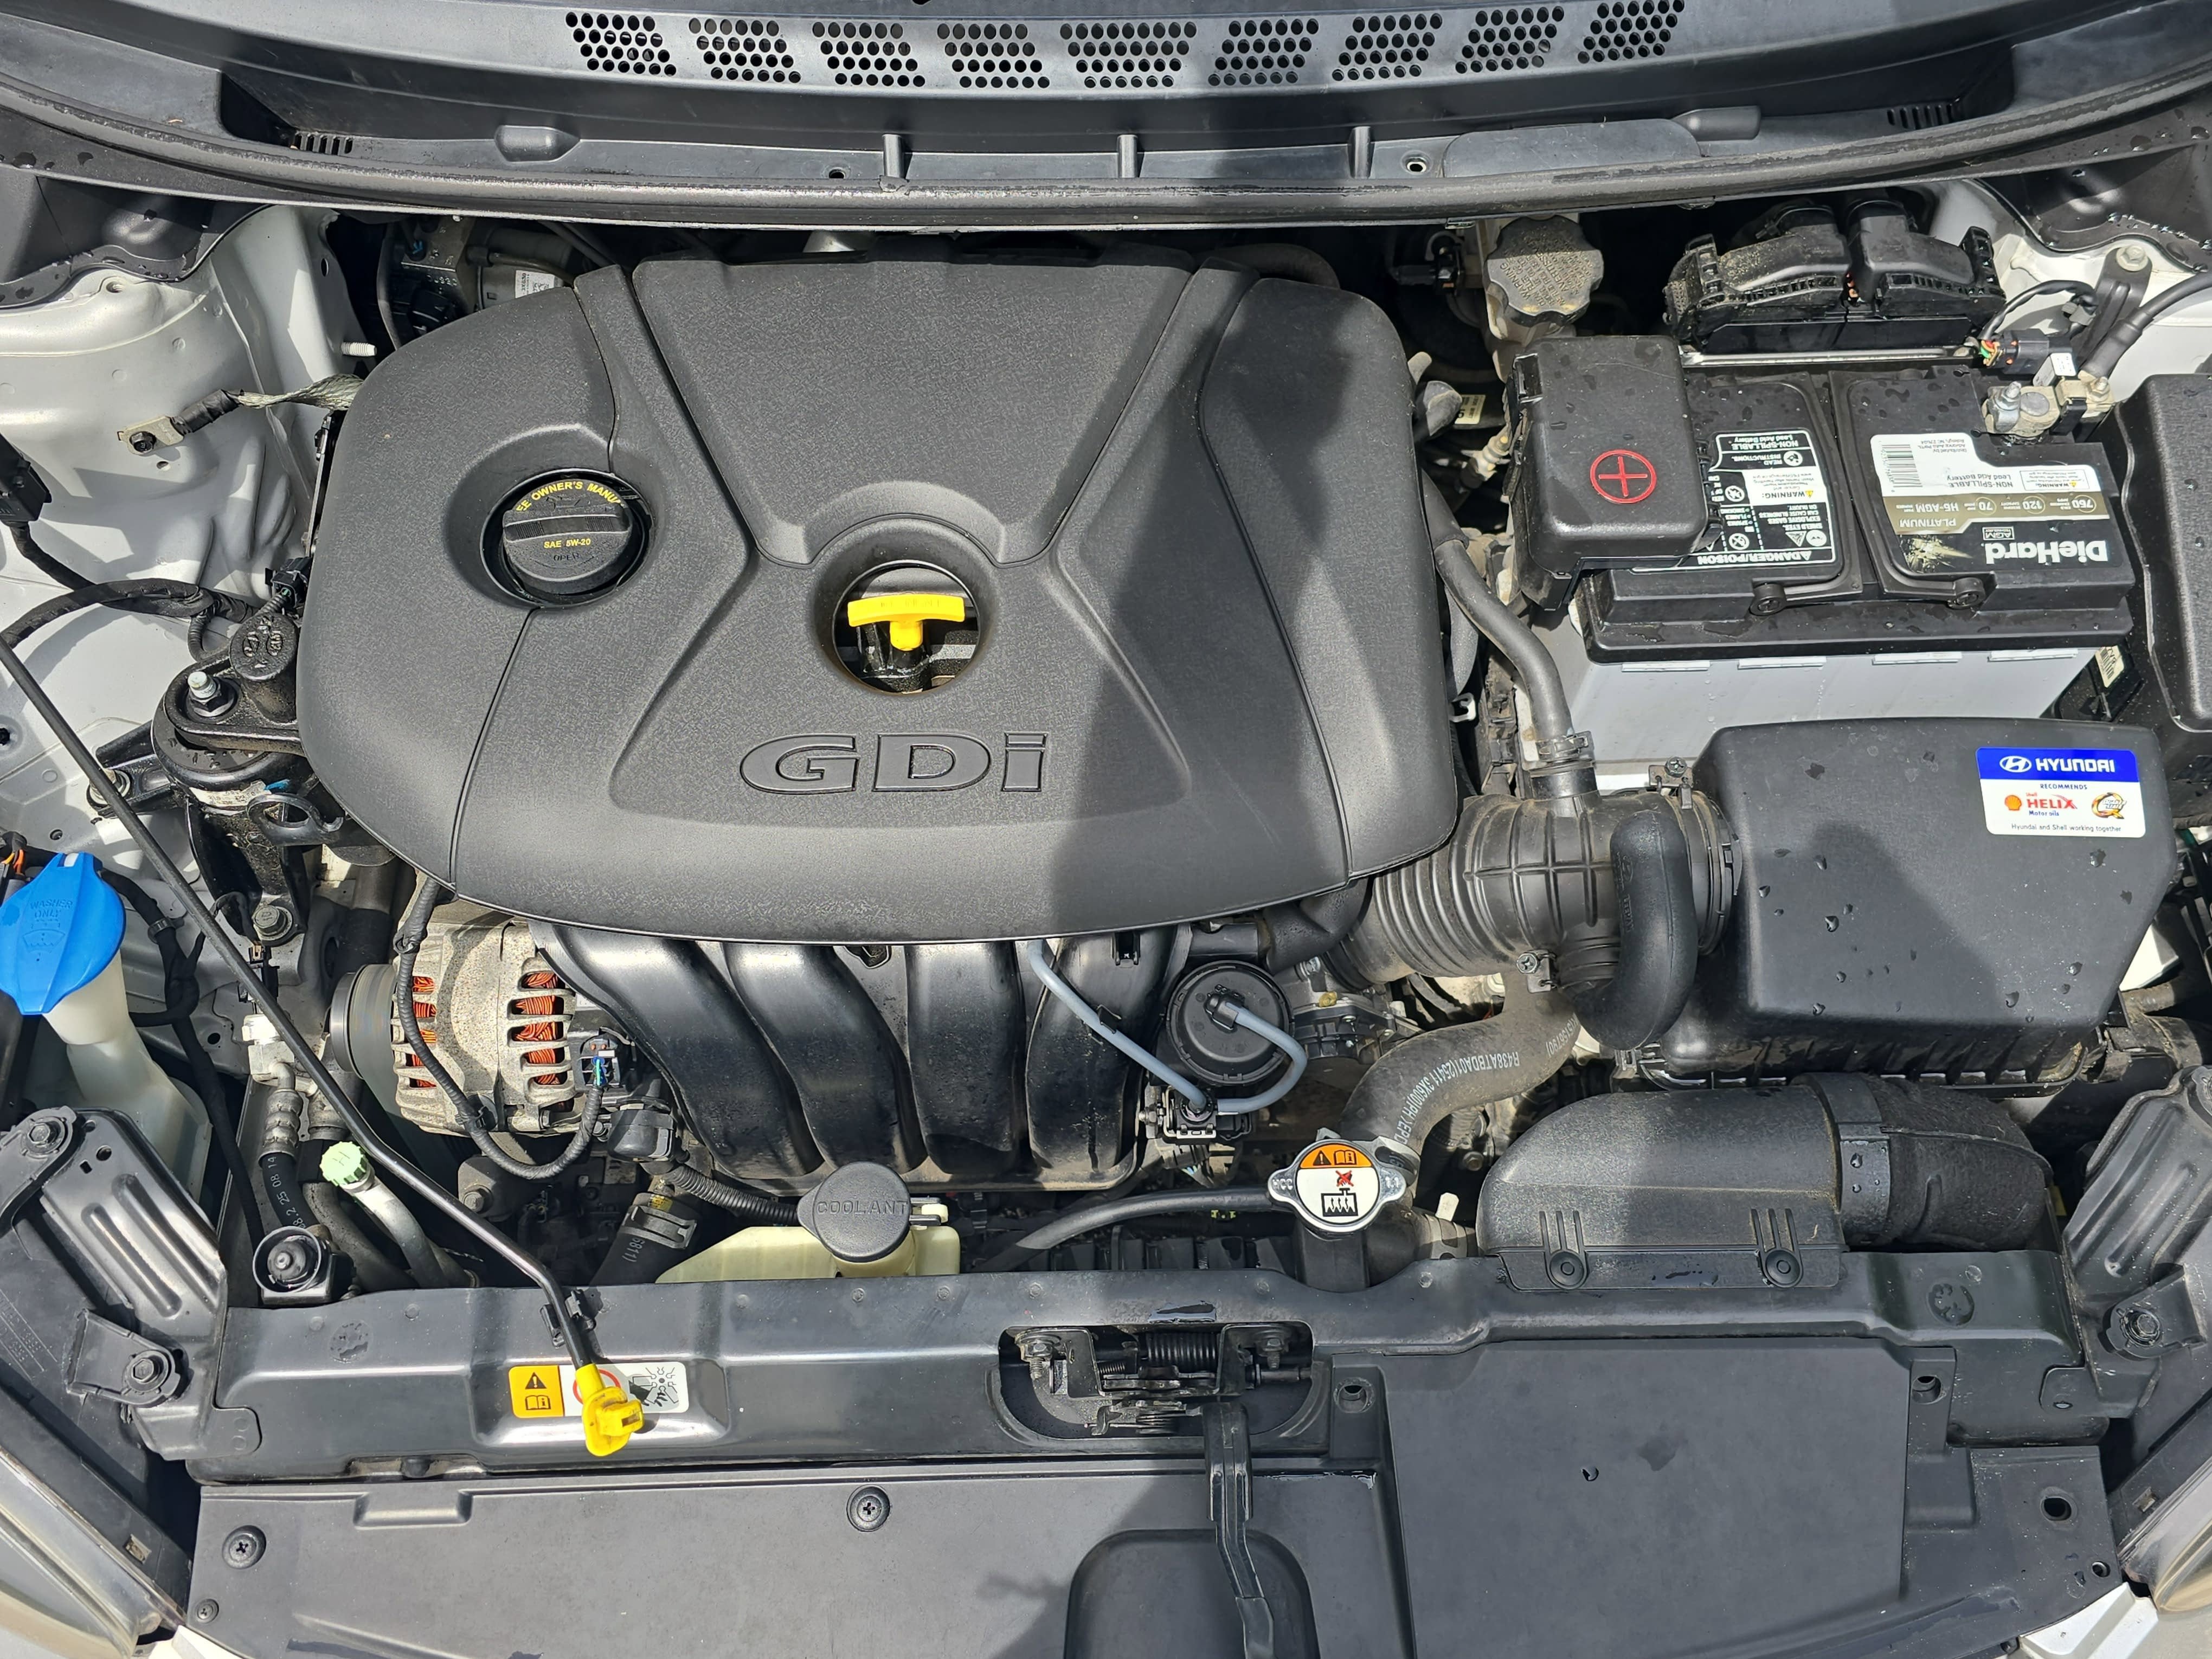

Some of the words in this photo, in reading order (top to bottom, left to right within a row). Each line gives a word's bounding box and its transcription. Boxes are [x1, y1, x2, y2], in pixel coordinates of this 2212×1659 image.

[1500, 262, 1531, 300] WARNING
[1731, 440, 1798, 450] NON-SPILLABLE
[531, 480, 583, 501] OWNER'S
[1978, 501, 1994, 511] 70
[2022, 500, 2043, 510] 120
[1899, 518, 1957, 528] PLATINUM
[543, 540, 562, 549] SAE
[565, 538, 591, 548] 5W-20
[1697, 550, 1802, 565] DANGER/POISON
[1985, 539, 2108, 564] DieHard
[740, 732, 1049, 795] GDi
[2035, 758, 2115, 773] HYUNDAI
[2027, 798, 2076, 809] HELIX
[30, 899, 74, 910] WASHER
[34, 909, 62, 918] ONLY
[1272, 1177, 1294, 1191] HCC
[815, 1200, 909, 1216] COOLANT
